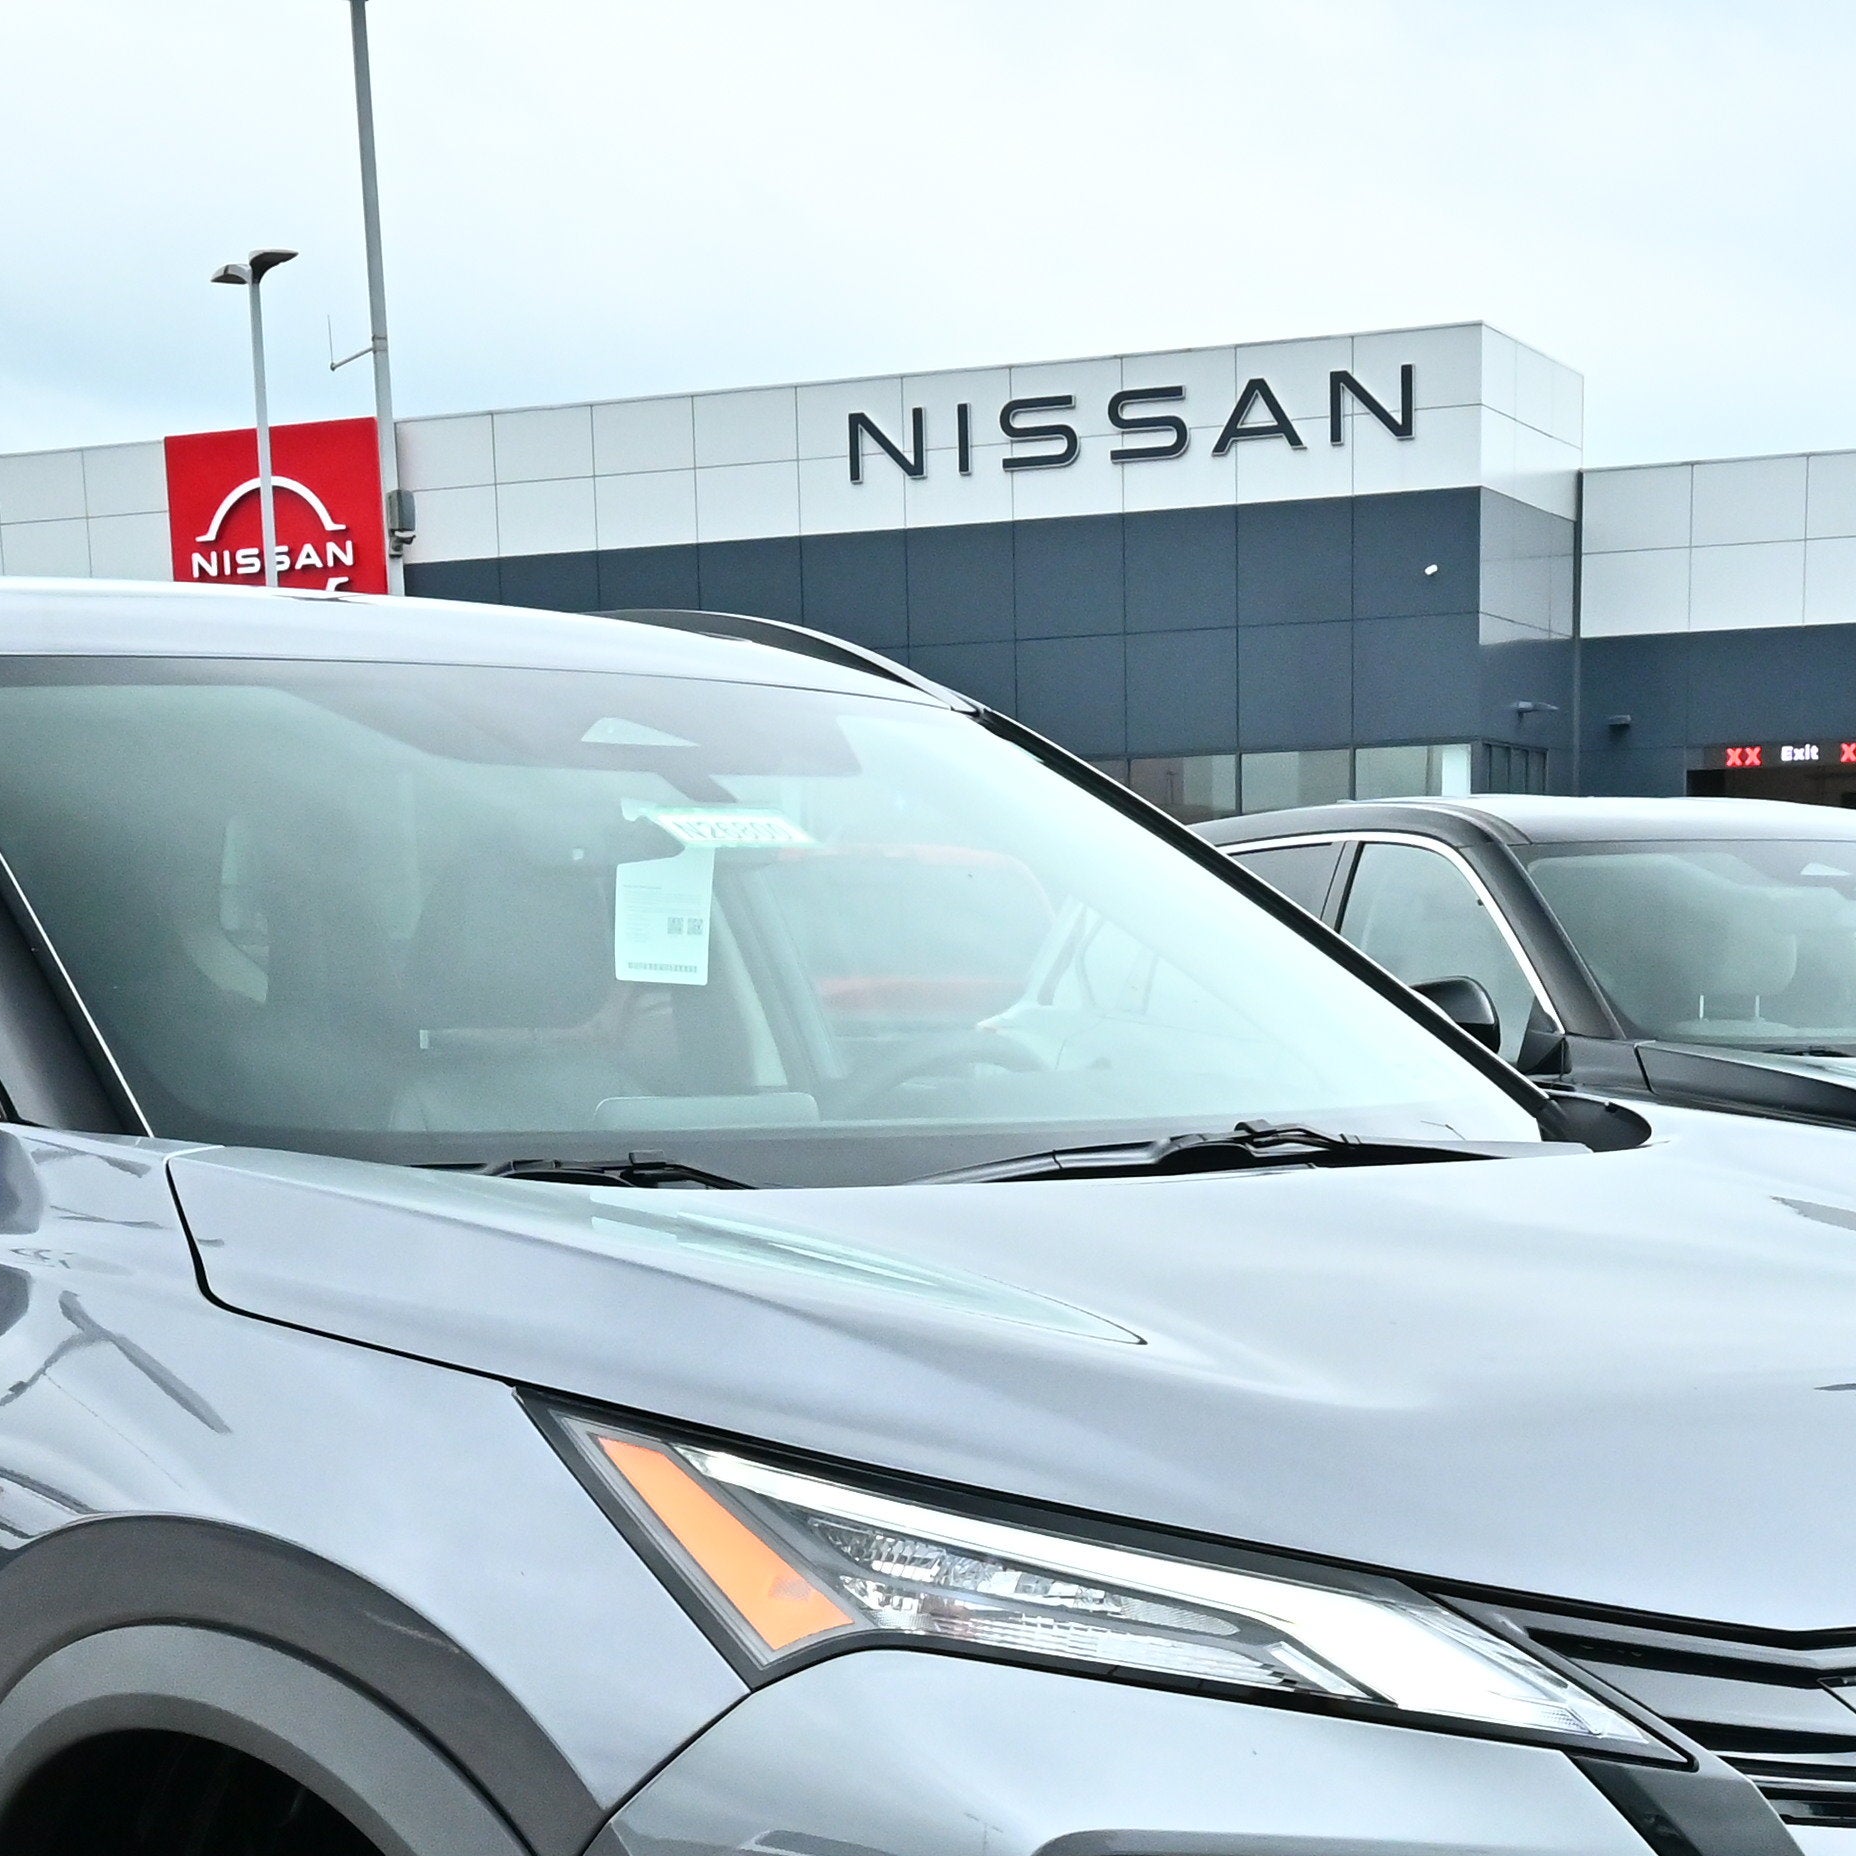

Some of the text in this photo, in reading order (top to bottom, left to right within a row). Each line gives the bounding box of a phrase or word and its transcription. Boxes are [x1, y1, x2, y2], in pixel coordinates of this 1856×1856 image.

[847, 363, 1416, 484] NISSAN
[191, 540, 354, 578] NISSAN
[1780, 744, 1819, 762] Exit
